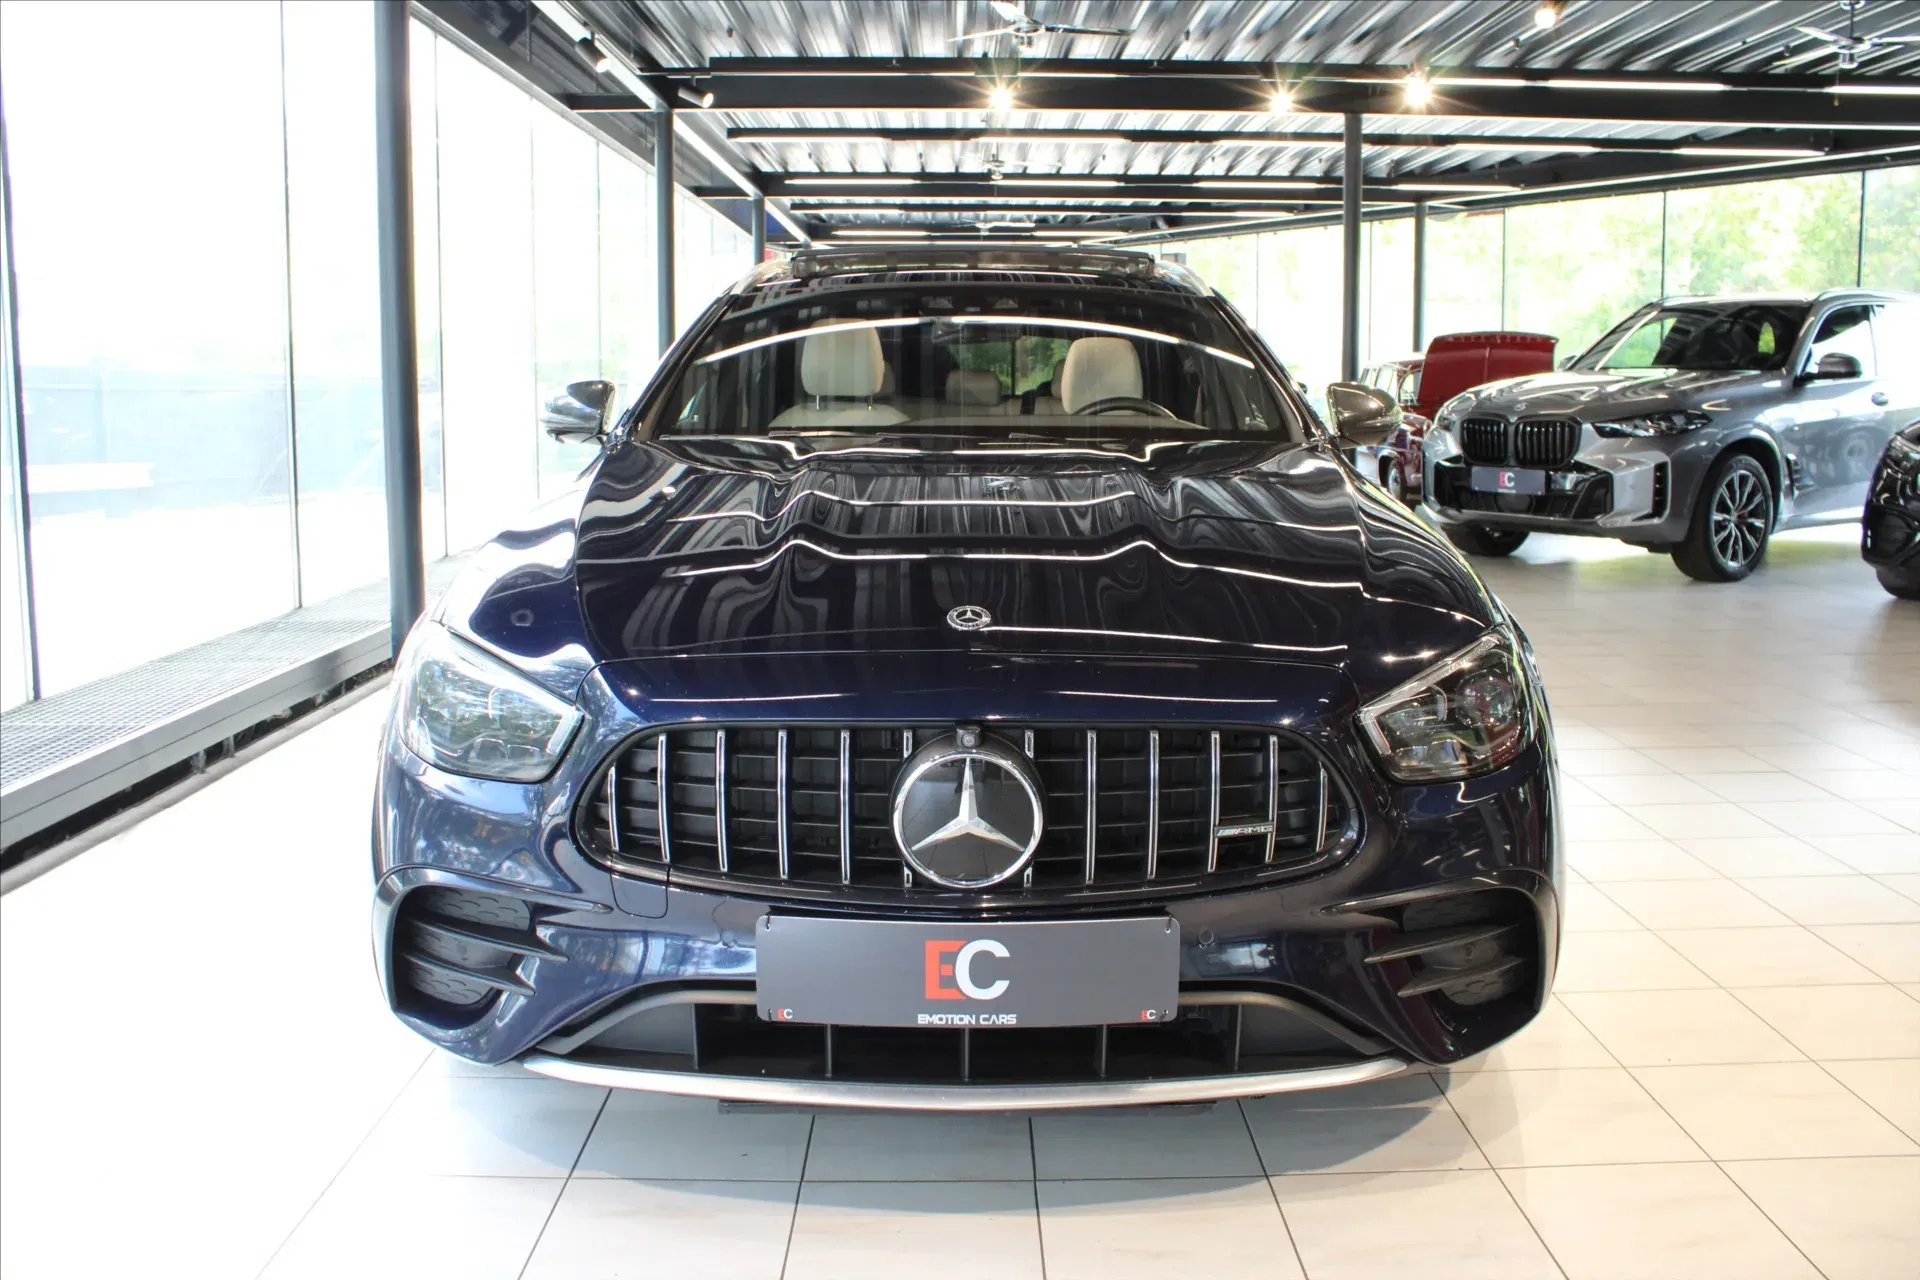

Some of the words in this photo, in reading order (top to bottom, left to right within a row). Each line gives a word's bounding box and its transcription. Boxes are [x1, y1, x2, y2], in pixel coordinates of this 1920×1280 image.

[925, 939, 1011, 1000] EC
[917, 1013, 976, 1025] EMOTION
[979, 1013, 1017, 1025] CARS
